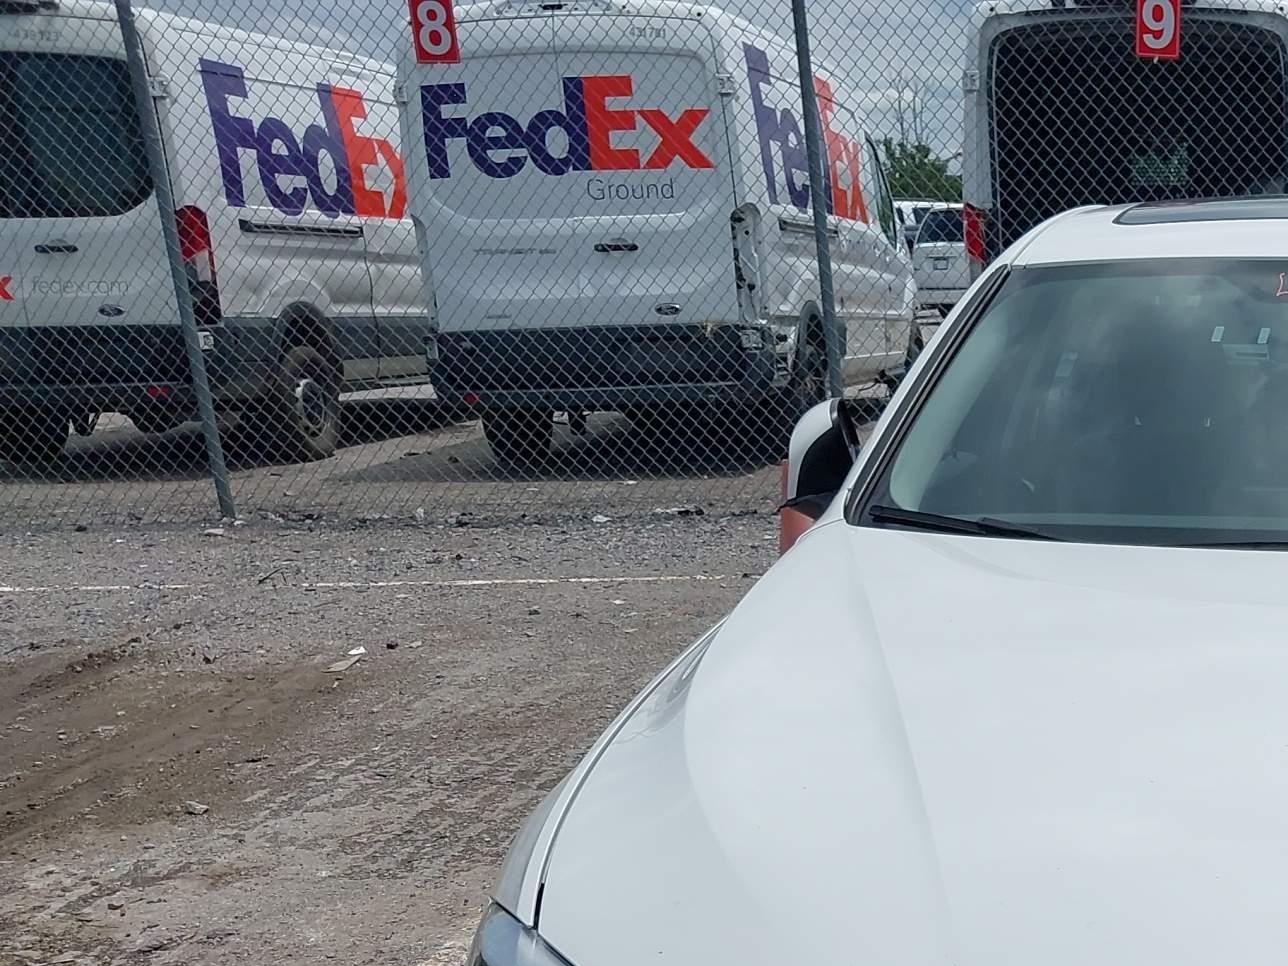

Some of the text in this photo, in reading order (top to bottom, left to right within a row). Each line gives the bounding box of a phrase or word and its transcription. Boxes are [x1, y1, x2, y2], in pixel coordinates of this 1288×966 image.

[417, 0, 452, 55] 8
[1143, 0, 1175, 49] 9
[420, 75, 715, 179] FedEx
[742, 41, 869, 225] FeEx
[586, 178, 675, 201] Ground
